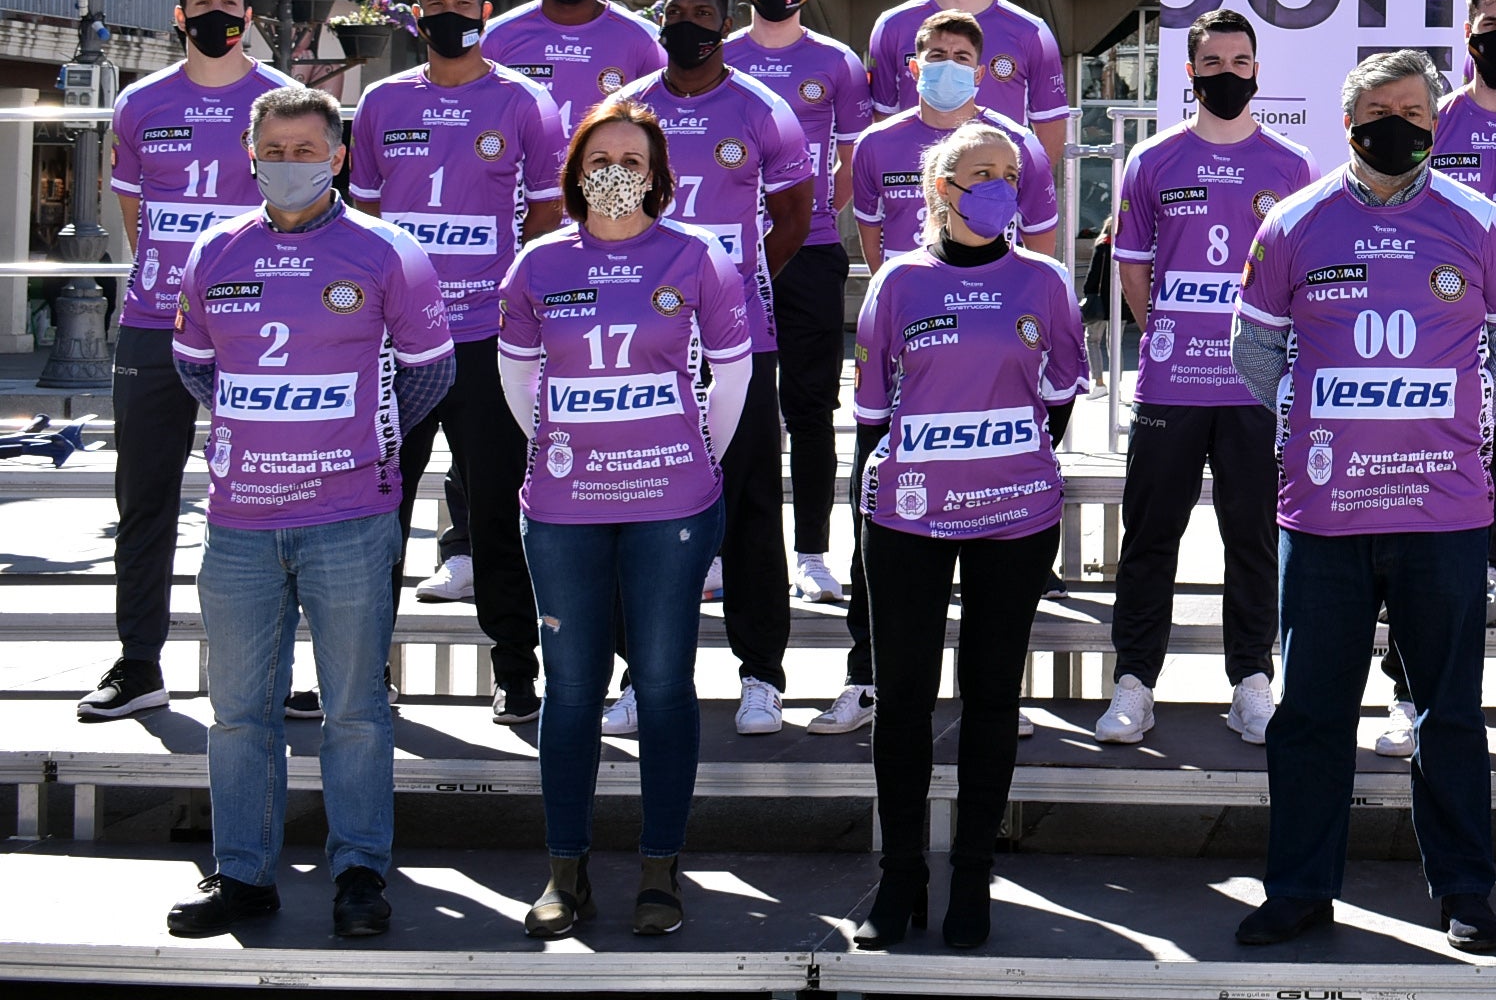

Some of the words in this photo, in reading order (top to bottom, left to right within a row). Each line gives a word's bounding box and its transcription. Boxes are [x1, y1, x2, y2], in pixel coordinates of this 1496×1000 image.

[148, 143, 192, 153] UCLM
[389, 147, 429, 157] UCLM
[184, 159, 219, 198] 11
[1450, 172, 1481, 182] CLM
[427, 166, 444, 207] 1
[667, 176, 704, 217] 7
[1169, 205, 1208, 216] UCLM
[1206, 224, 1229, 266] 8
[438, 279, 496, 289] tamiento
[1315, 288, 1368, 301] UCLM
[210, 303, 261, 315] UCLM
[550, 306, 596, 318] UCLM
[910, 333, 959, 352] UCLM
[1354, 310, 1416, 359] 00
[258, 322, 290, 367] 2
[583, 324, 637, 369] 17
[1185, 348, 1201, 357] de
[1170, 375, 1244, 386] #somosiguale
[219, 380, 350, 410] Vestas
[550, 382, 676, 413] Vestas
[1316, 377, 1452, 407] Vestas
[903, 418, 1034, 452] Vestas
[242, 448, 351, 464] Ayuntamiento
[589, 442, 690, 461] Ayuntamiento
[1349, 450, 1453, 464] Ayuntamiento
[241, 463, 256, 473] de
[260, 462, 316, 475] Ciudad
[321, 458, 356, 472] Real
[585, 462, 603, 472] de
[606, 458, 660, 472] Ciudad
[664, 452, 694, 467] Real
[1347, 466, 1365, 477] de
[1369, 463, 1424, 476] Ciudad
[230, 478, 322, 494] #somosdistintas
[572, 477, 669, 491] #somosdistintas
[1331, 484, 1429, 500] #somosdistintas
[230, 489, 316, 506] #somosiguales
[571, 488, 664, 503] #somosiguales
[1330, 496, 1423, 512] #somosiguales
[930, 508, 1029, 531] #somosdistintas
[436, 783, 509, 793] GUIL
[1276, 990, 1362, 1000] GUIL
